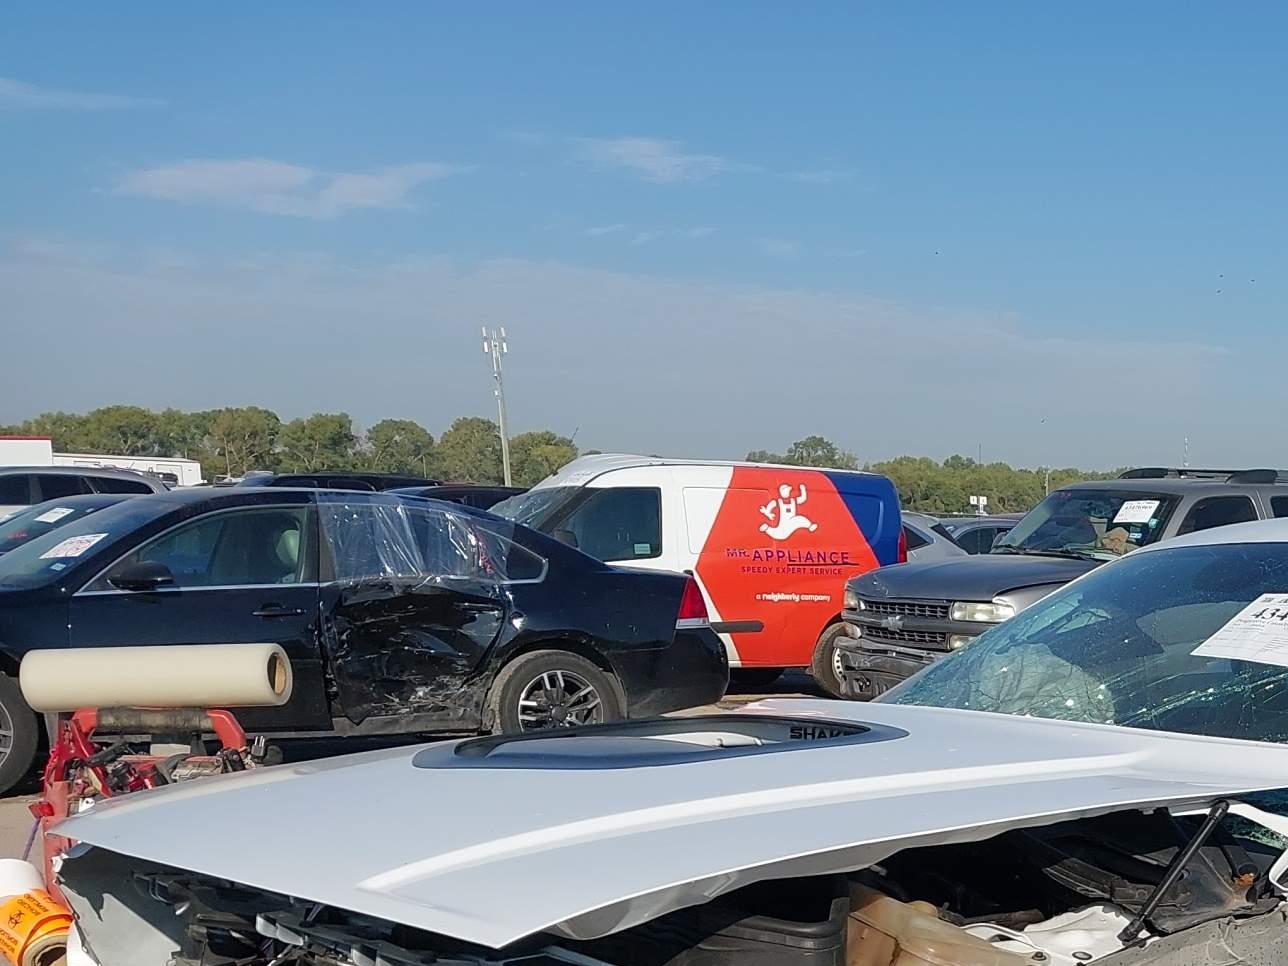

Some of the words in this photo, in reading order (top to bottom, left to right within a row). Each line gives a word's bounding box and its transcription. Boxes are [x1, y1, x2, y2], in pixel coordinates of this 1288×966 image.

[726, 548, 750, 558] MR.
[752, 549, 850, 564] APPLIANCE
[741, 566, 773, 574] SPEEDY
[776, 567, 806, 575] EXPERT
[809, 568, 843, 576] SERVICE
[800, 594, 831, 602] company
